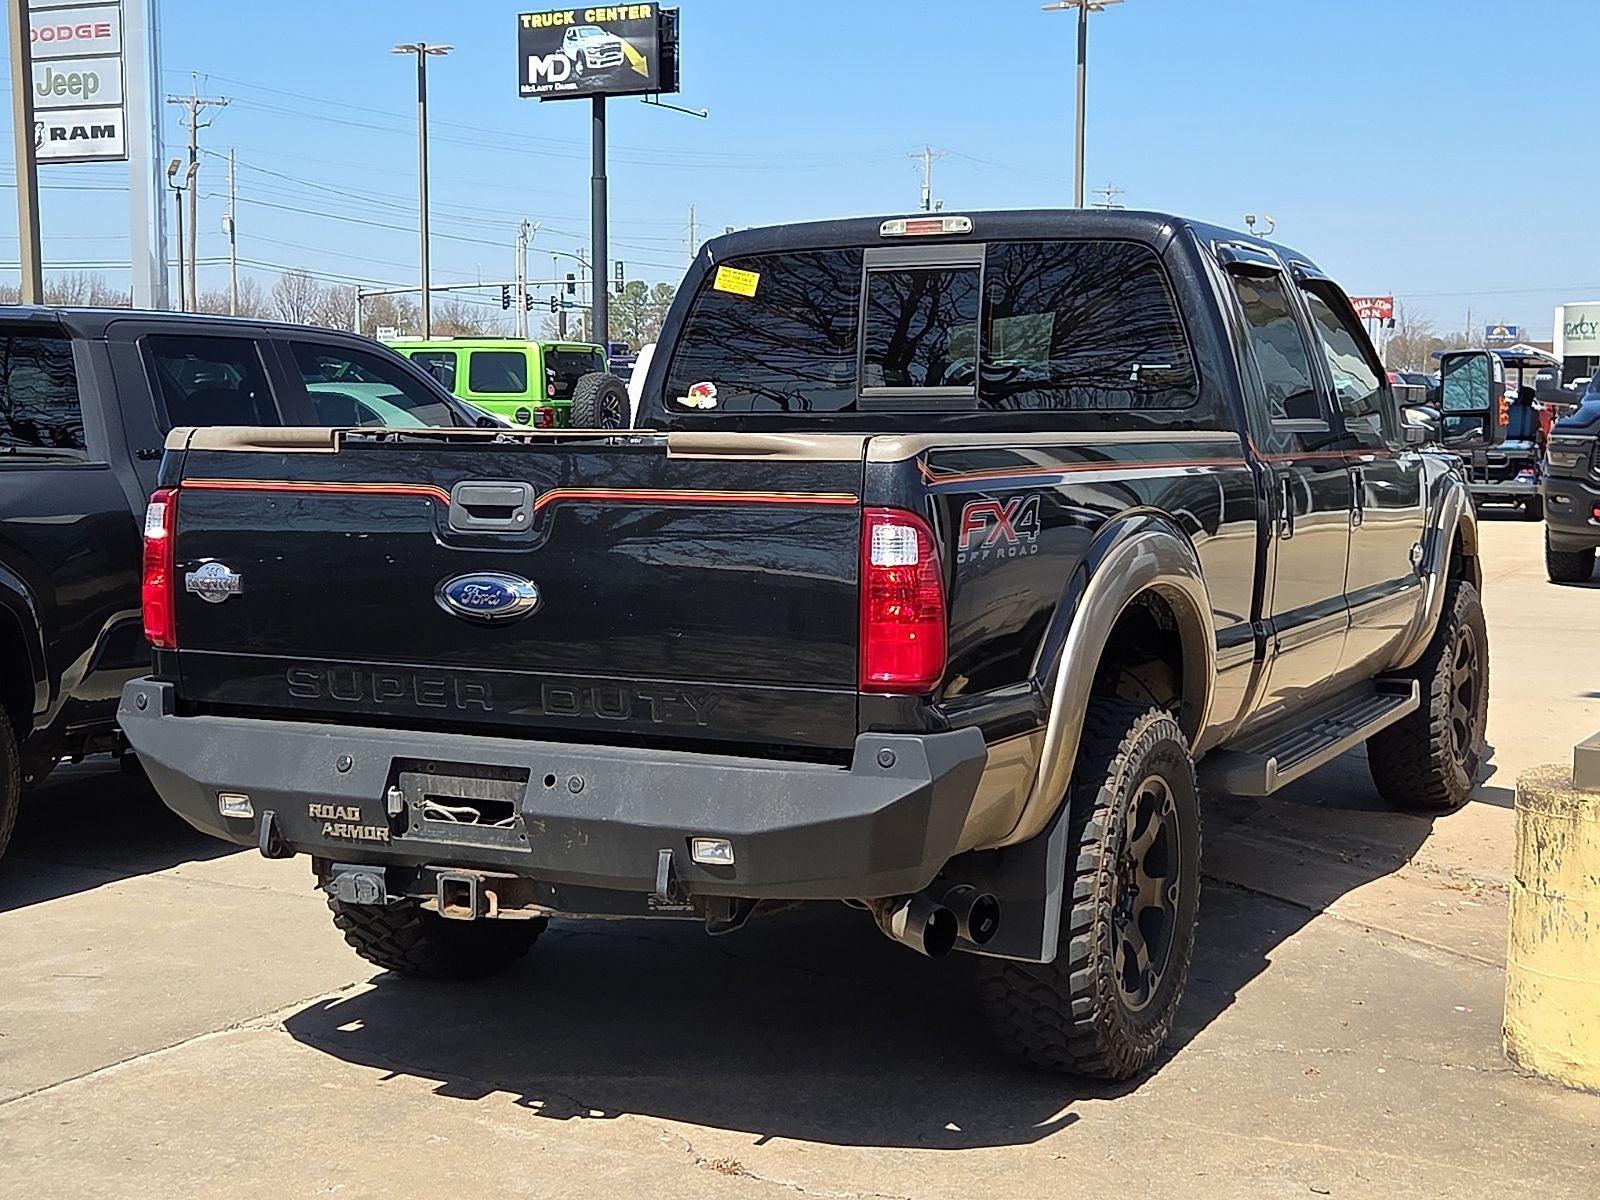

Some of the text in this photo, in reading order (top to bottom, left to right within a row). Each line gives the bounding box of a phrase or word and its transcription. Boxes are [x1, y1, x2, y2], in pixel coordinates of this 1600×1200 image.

[520, 5, 651, 28] TRUCK CENTER
[528, 54, 571, 83] MD
[36, 67, 99, 100] Jeep
[50, 125, 115, 141] RAM
[958, 494, 1041, 551] FX4
[957, 544, 1039, 564] OFF ROAD
[461, 584, 501, 605] Ford
[286, 666, 721, 726] SUPER DUTY
[308, 803, 361, 821] ROAD
[321, 821, 390, 841] ARMOR
